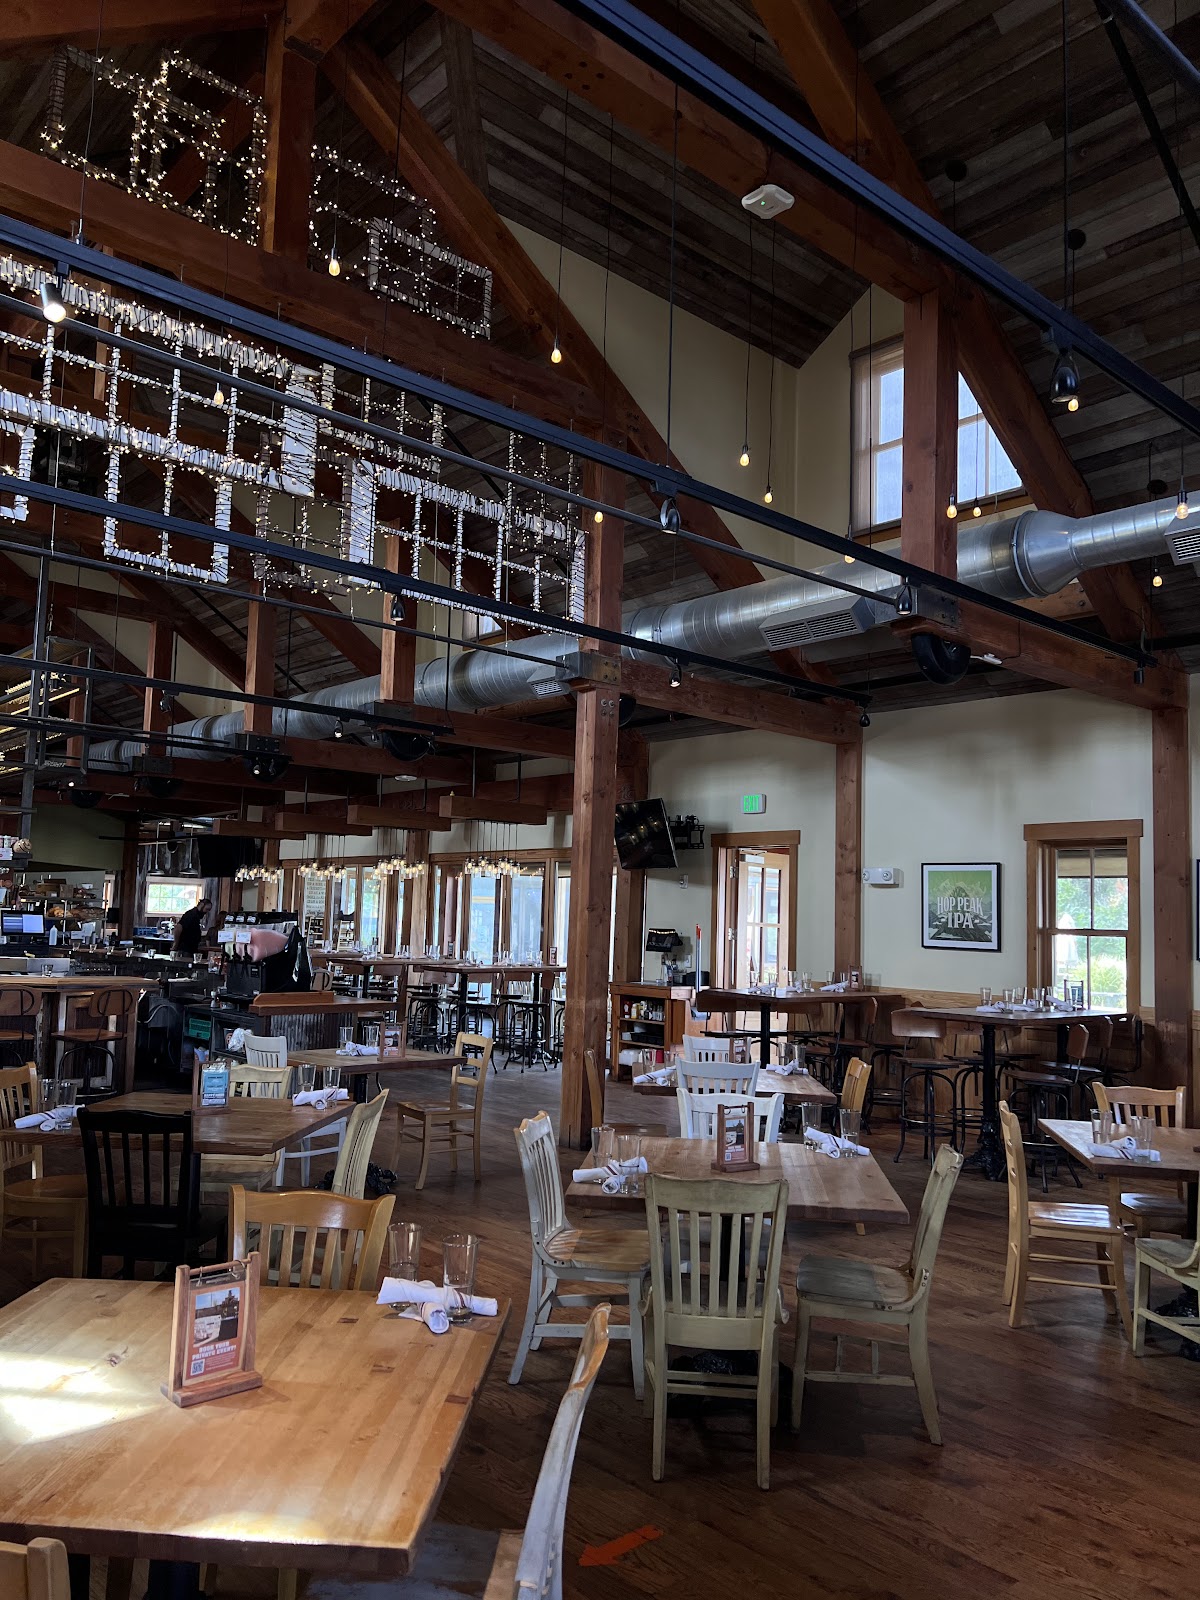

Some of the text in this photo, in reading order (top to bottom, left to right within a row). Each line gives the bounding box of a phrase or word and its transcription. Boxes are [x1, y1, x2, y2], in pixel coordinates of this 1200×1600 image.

[744, 795, 759, 811] EXIT
[937, 896, 984, 916] HOP PEAK
[947, 912, 974, 928] IPA
[192, 1350, 216, 1360] PRIVATE
[198, 1341, 230, 1353] BOOK YOUR
